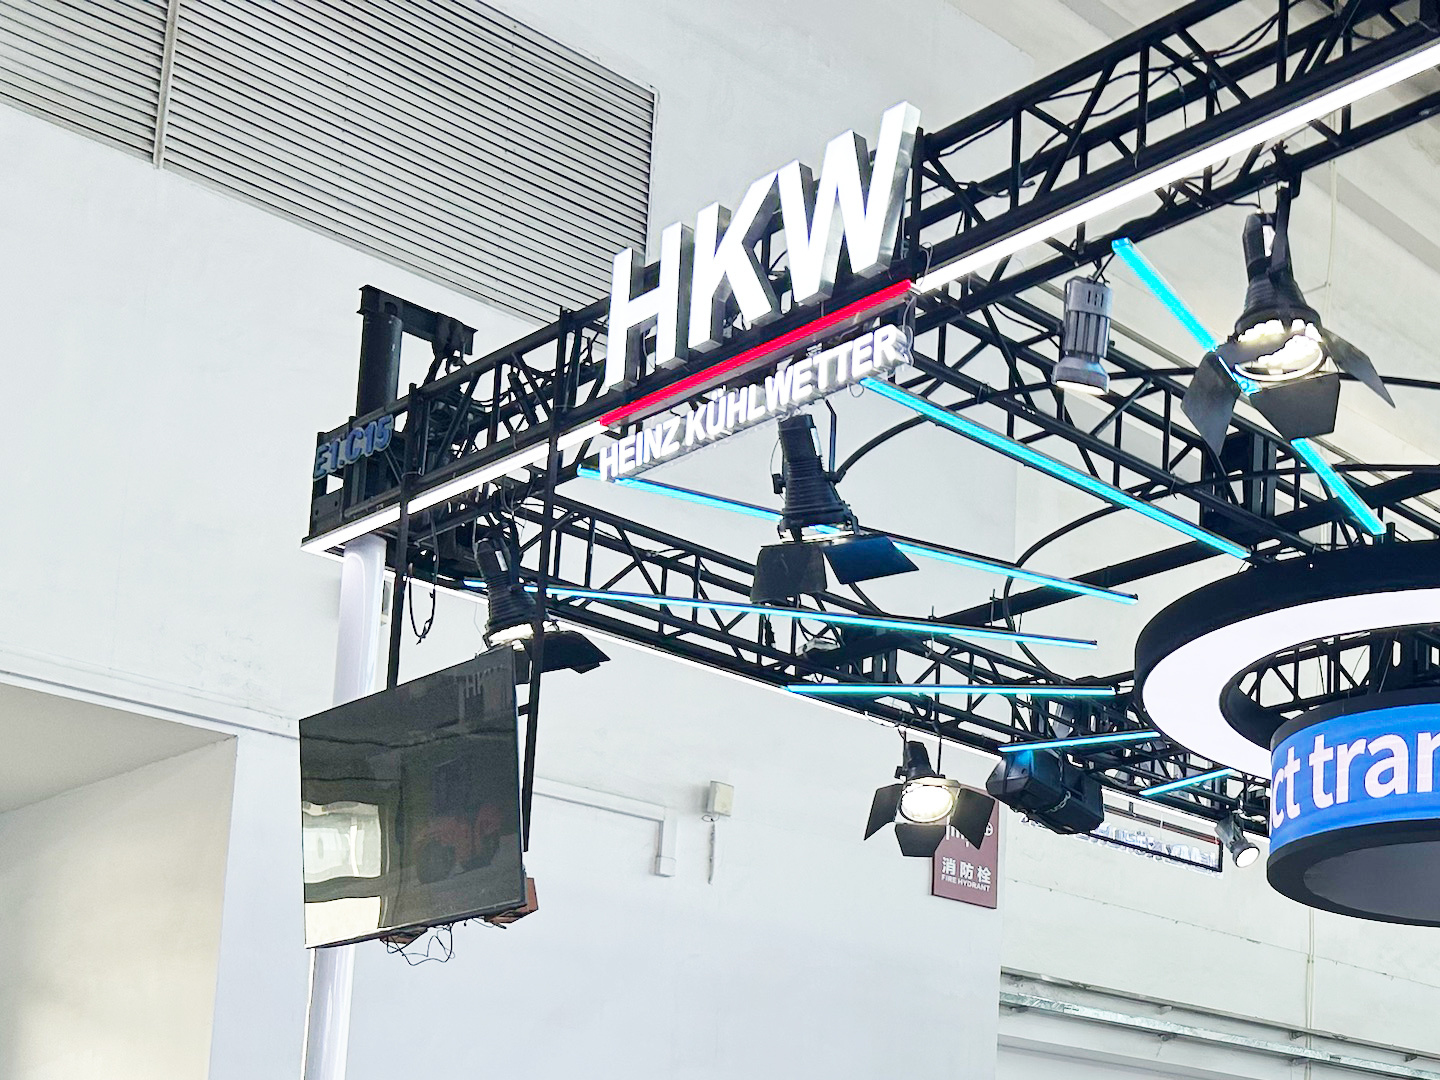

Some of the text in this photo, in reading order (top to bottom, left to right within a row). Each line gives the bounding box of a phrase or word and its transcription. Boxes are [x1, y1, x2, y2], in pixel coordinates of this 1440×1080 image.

[600, 101, 918, 390] HKW
[600, 323, 908, 481] HEINZ KÜHLWETTER
[313, 413, 394, 481] E1.C15
[1271, 747, 1300, 830] ct
[941, 874, 991, 892] FIRE HYDRANT
[942, 857, 991, 884] 消防栓
